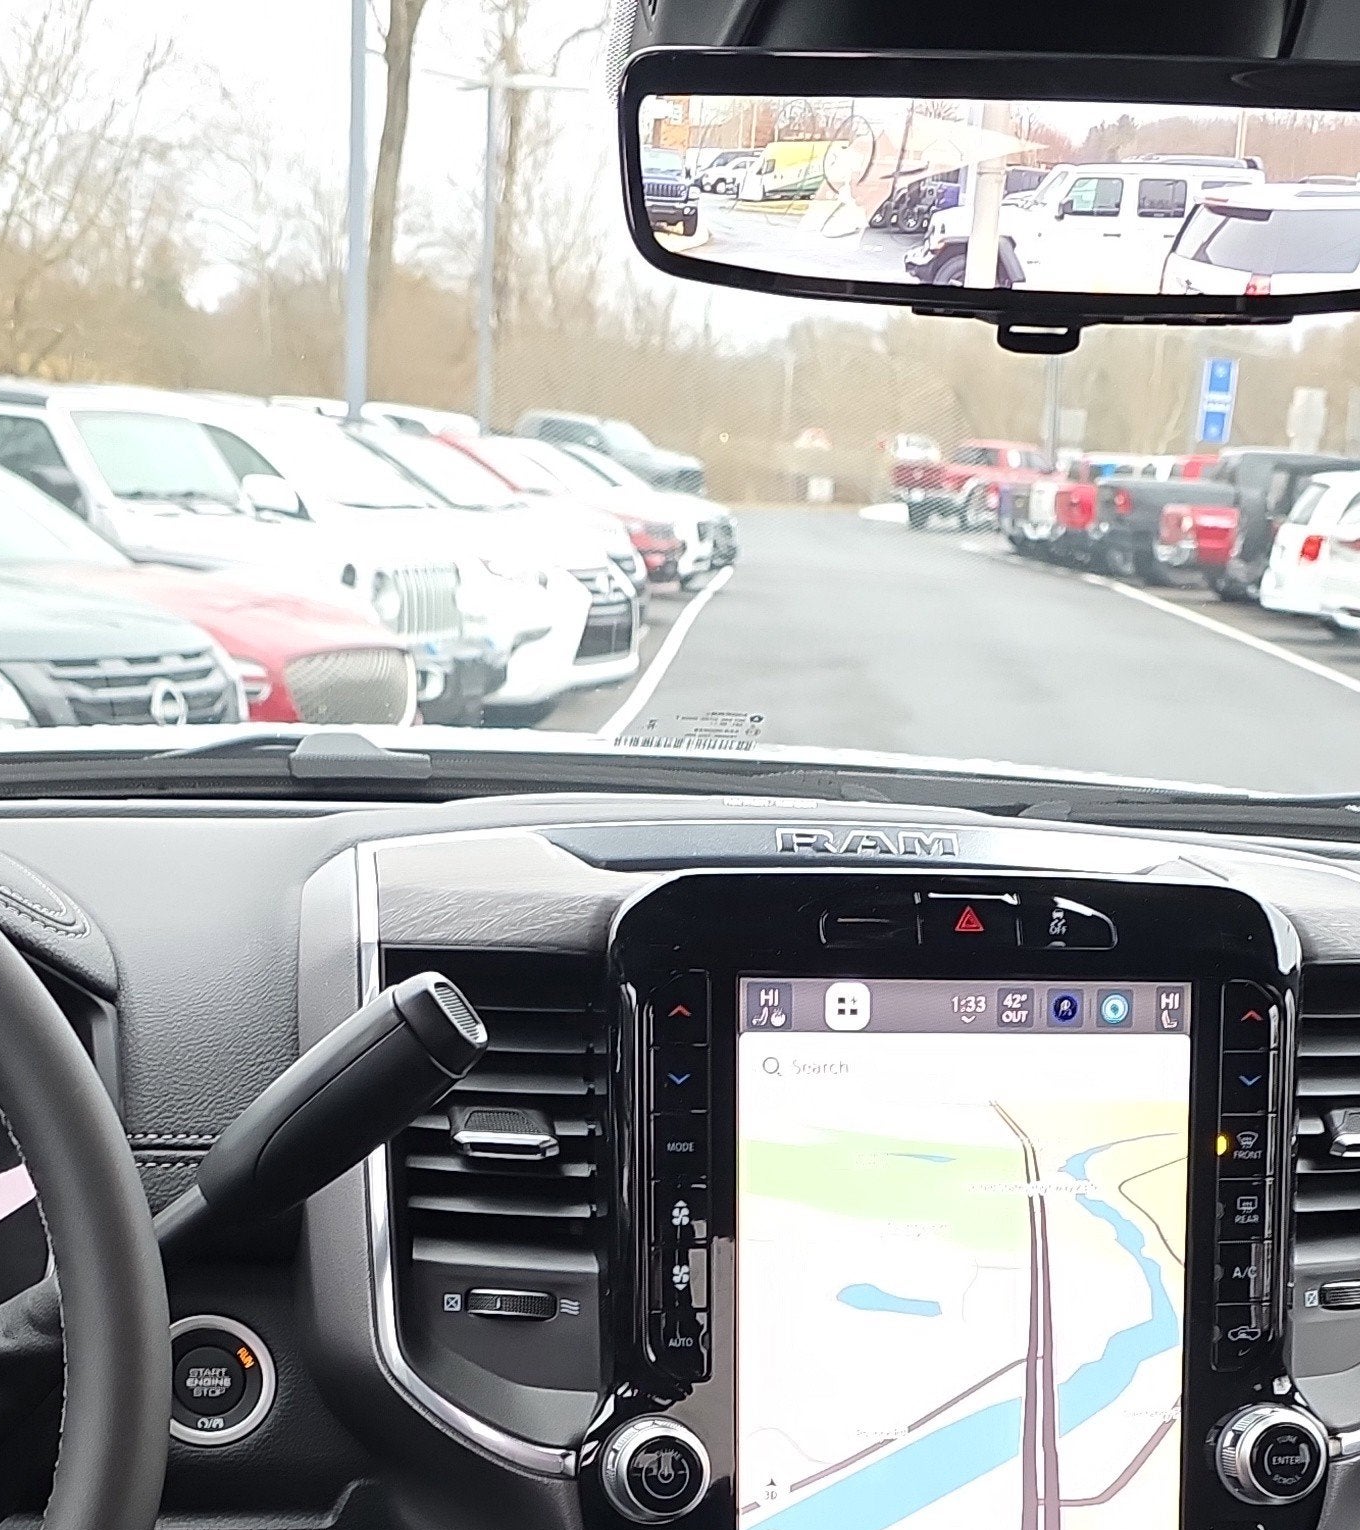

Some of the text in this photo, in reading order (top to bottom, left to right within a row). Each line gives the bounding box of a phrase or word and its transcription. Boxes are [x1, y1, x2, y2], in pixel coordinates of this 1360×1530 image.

[776, 827, 960, 856] RAM
[759, 988, 779, 1007] HI
[1160, 992, 1180, 1009] HI
[951, 994, 987, 1013] 1:33
[1001, 1010, 1029, 1023] OUT
[792, 1059, 849, 1075] Search
[667, 1142, 695, 1152] MODE
[1233, 1150, 1263, 1159] FRONT
[1234, 1214, 1260, 1224] REAR
[1232, 1266, 1258, 1279] A/C
[668, 1337, 694, 1347] AUTO
[189, 1367, 228, 1378] START
[186, 1377, 232, 1387] ENGINE
[193, 1387, 226, 1397] STOP
[764, 1489, 778, 1500] 3D
